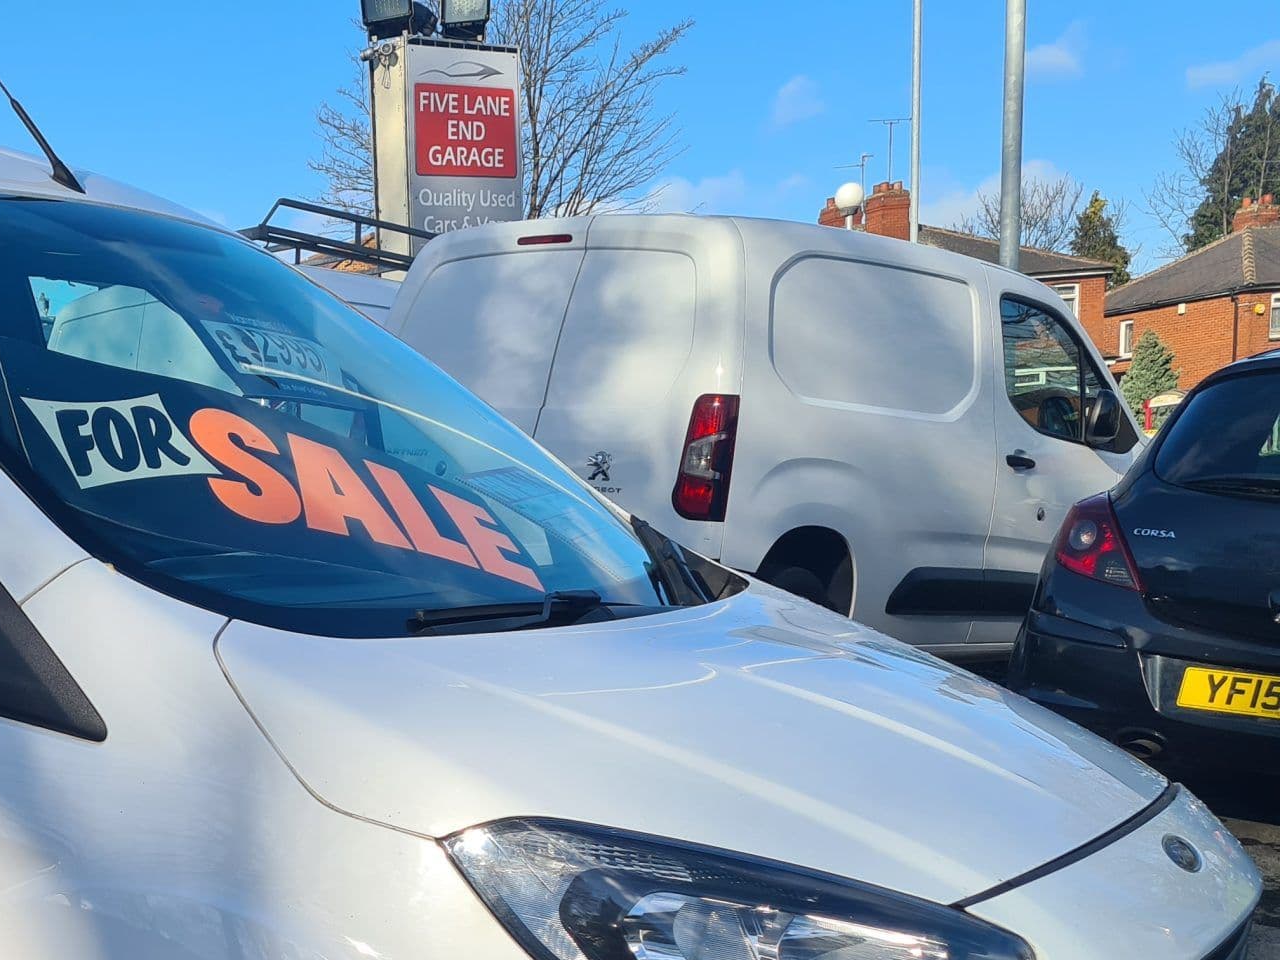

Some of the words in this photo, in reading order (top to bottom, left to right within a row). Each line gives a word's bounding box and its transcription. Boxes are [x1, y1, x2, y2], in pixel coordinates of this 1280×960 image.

[419, 91, 459, 114] FIVE
[464, 95, 510, 117] LANE
[447, 120, 486, 141] END
[428, 146, 505, 168] GARAGE
[419, 188, 476, 212] Quality
[480, 190, 516, 208] Used
[424, 216, 457, 234] Cars
[55, 405, 191, 477] FOR
[189, 407, 546, 593] SALE
[1133, 527, 1176, 539] CORSA
[1207, 673, 1280, 711] YF15
